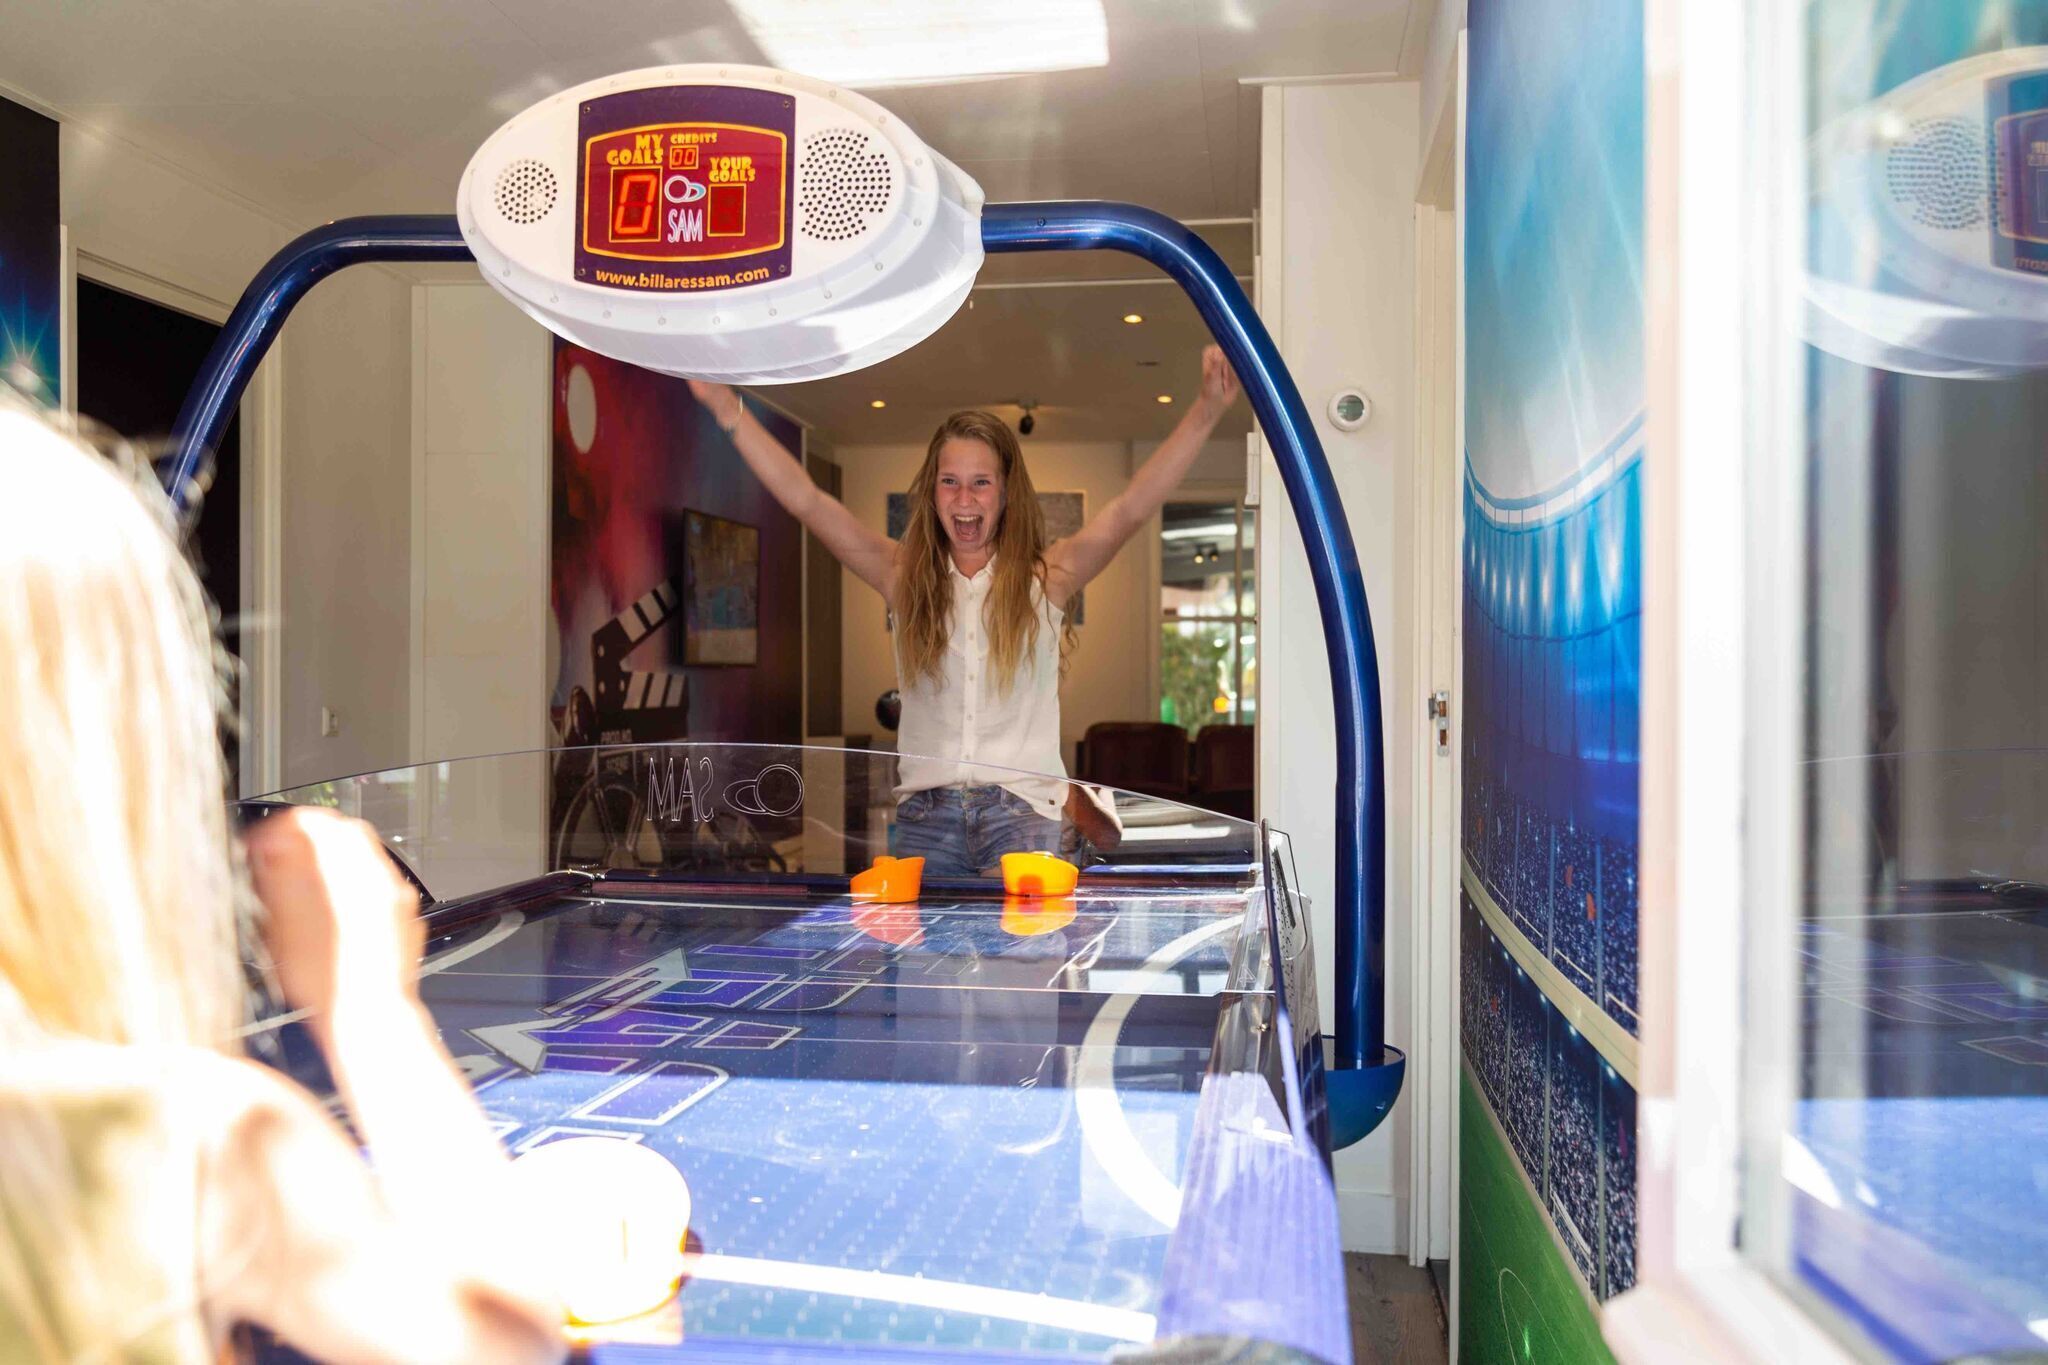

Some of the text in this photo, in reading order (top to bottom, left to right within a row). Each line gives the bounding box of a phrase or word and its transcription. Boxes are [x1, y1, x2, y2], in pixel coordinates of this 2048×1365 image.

[635, 134, 663, 150] MY
[670, 132, 718, 144] CREDITS
[606, 149, 664, 165] GOALS
[710, 157, 752, 170] YOUR
[708, 169, 756, 182] GOALS
[667, 208, 703, 243] SAM
[595, 267, 769, 288] www.billaressam.com
